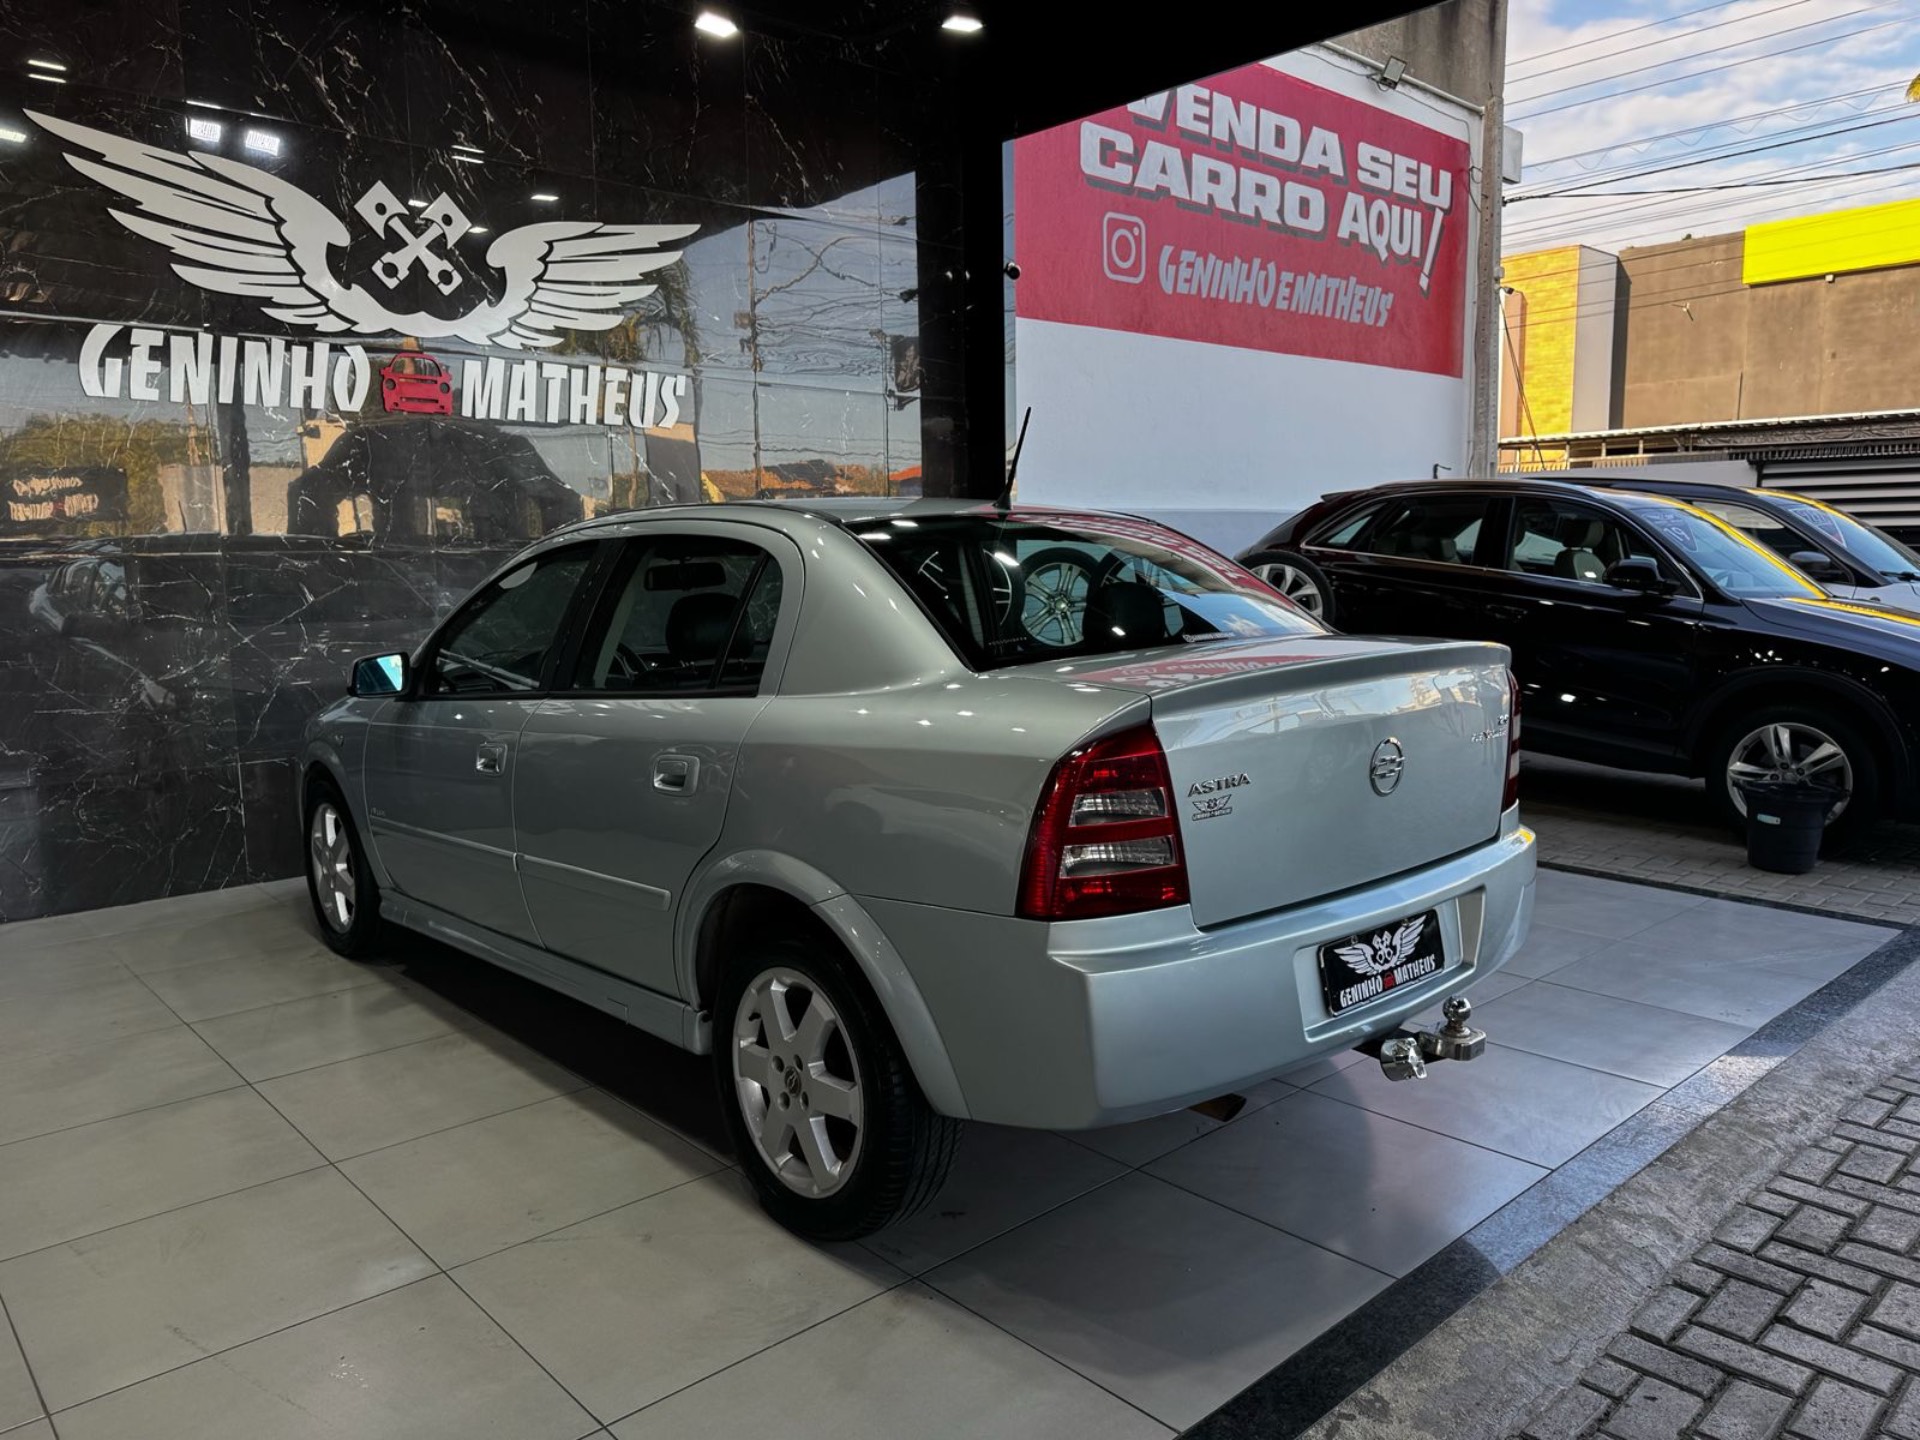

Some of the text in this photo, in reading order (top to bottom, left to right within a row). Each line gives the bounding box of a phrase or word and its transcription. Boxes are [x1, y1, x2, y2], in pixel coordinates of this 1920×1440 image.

[1127, 84, 1452, 210] VENDA SEU
[1080, 120, 1444, 292] CARRO AQUI!
[78, 323, 686, 430] GENINHO MATHEUS
[1187, 772, 1251, 798] ASTRA
[1339, 953, 1436, 1008] GENINHO MATHEUS
